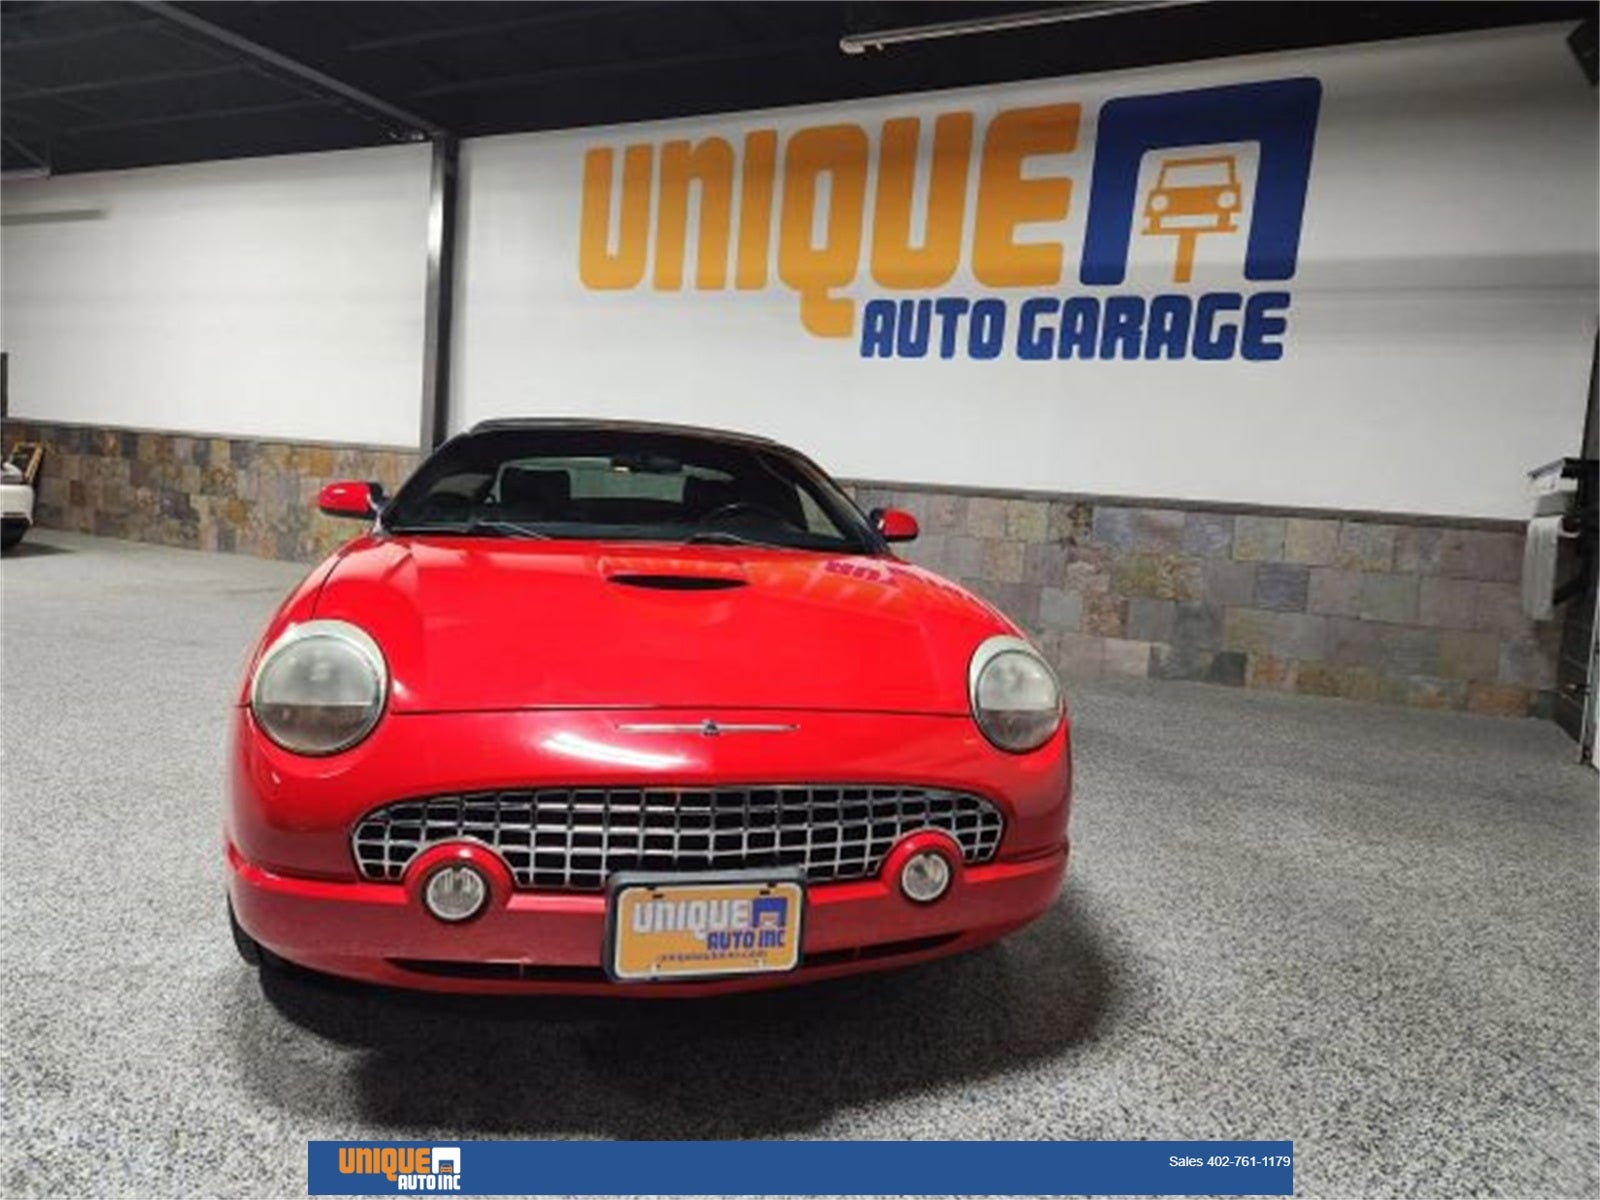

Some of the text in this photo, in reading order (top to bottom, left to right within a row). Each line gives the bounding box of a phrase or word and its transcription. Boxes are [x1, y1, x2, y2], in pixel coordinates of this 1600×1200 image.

[579, 102, 1082, 338] UNIQUE
[860, 291, 1291, 361] AUTO GARAGE
[632, 898, 750, 940] UNIQUE
[707, 929, 786, 950] AUTO INC
